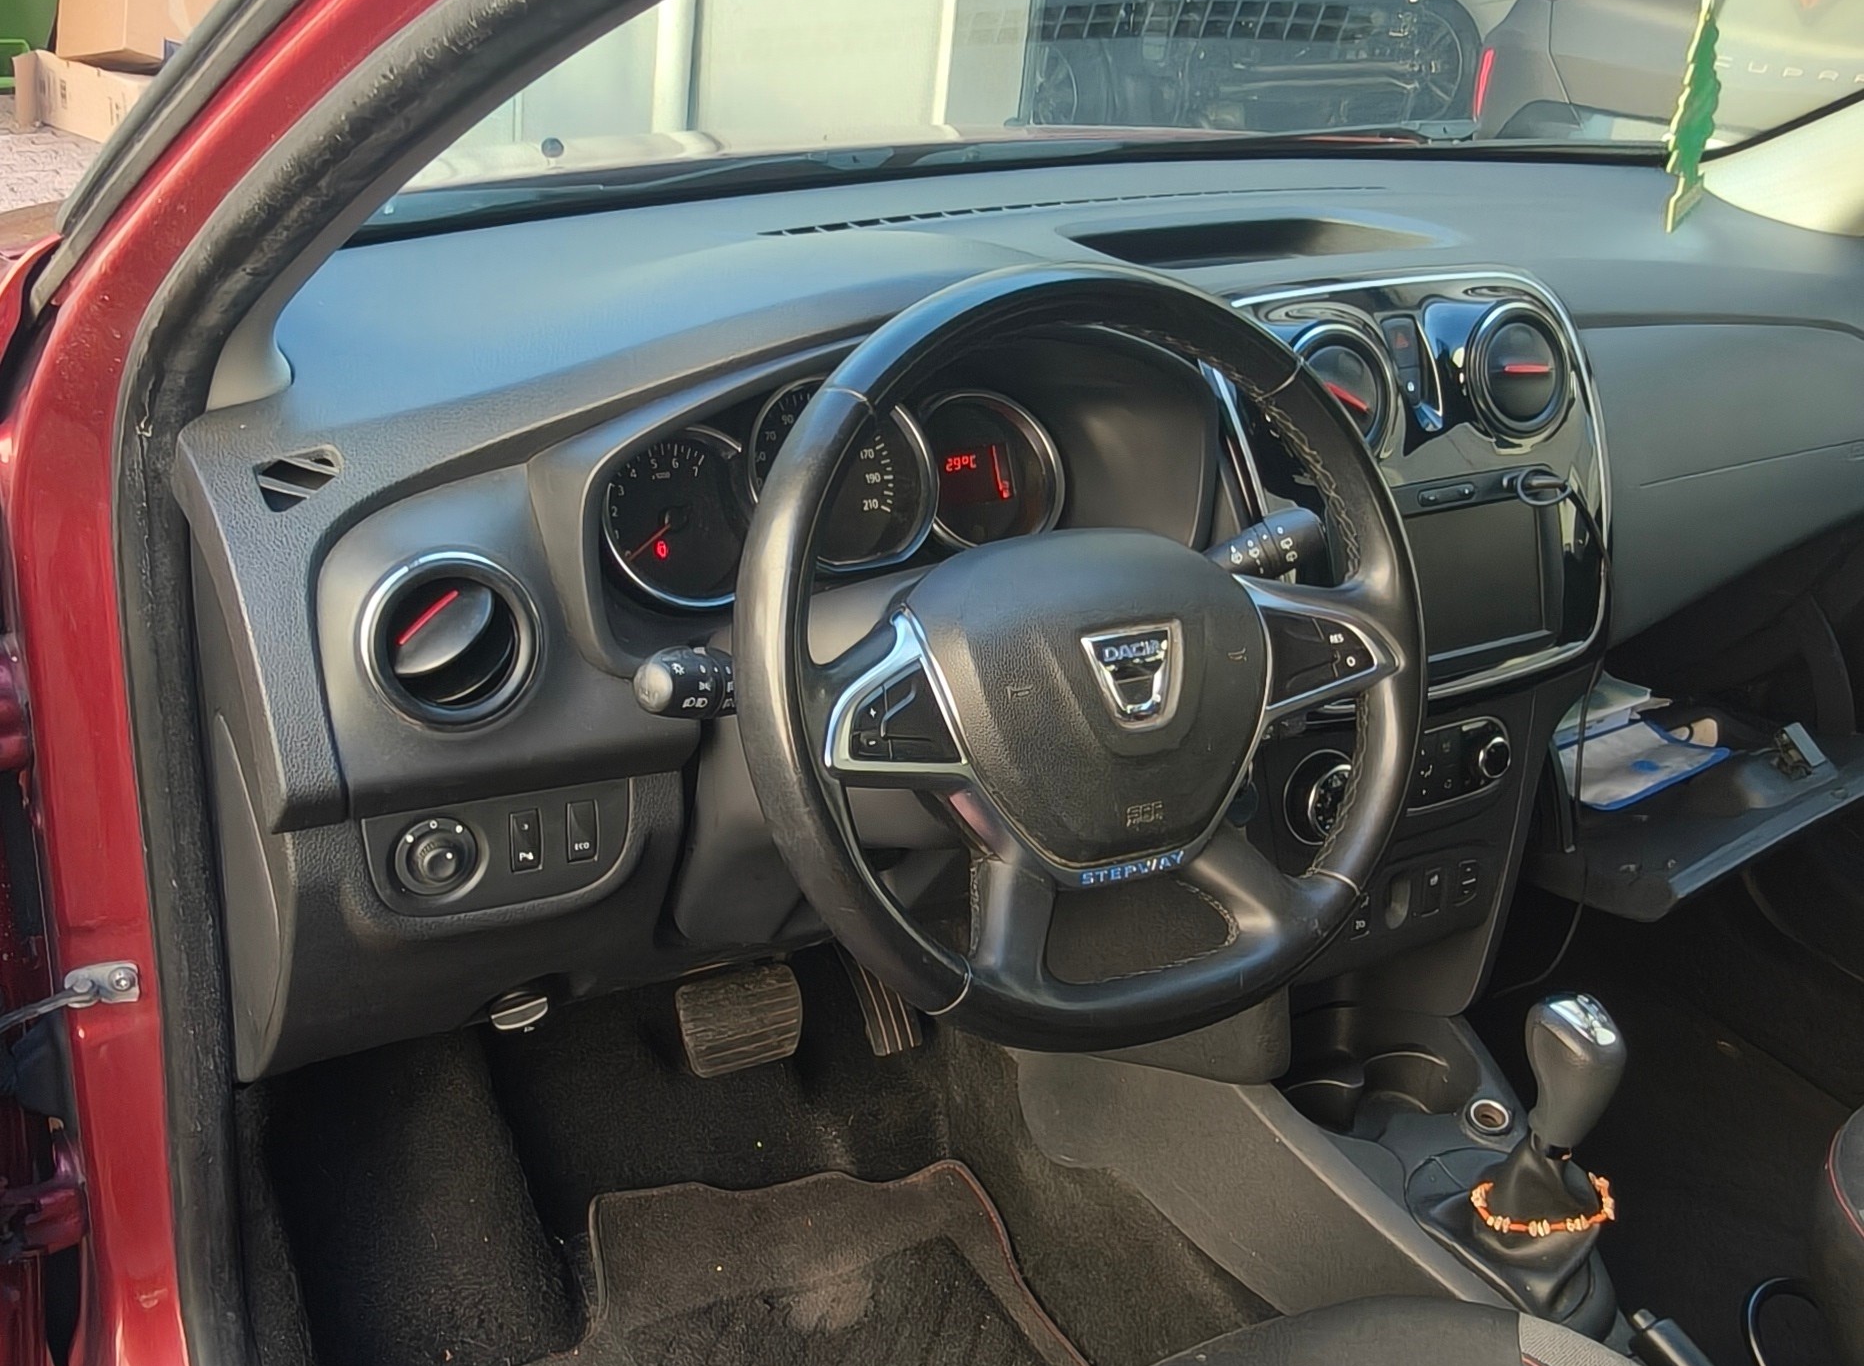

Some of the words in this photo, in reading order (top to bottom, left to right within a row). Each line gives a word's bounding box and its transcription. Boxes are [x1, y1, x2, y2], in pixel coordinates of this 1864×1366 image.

[764, 431, 777, 441] 70
[860, 448, 875, 460] 170
[650, 458, 658, 469] 5
[671, 458, 679, 469] 6
[692, 466, 699, 477] 7
[865, 472, 881, 484] 190
[618, 484, 625, 496] 3
[862, 498, 879, 511] 210
[611, 505, 618, 517] 2
[1103, 639, 1160, 663] DACIA
[574, 841, 590, 851] ECO
[1081, 850, 1184, 885] STEPWAY
